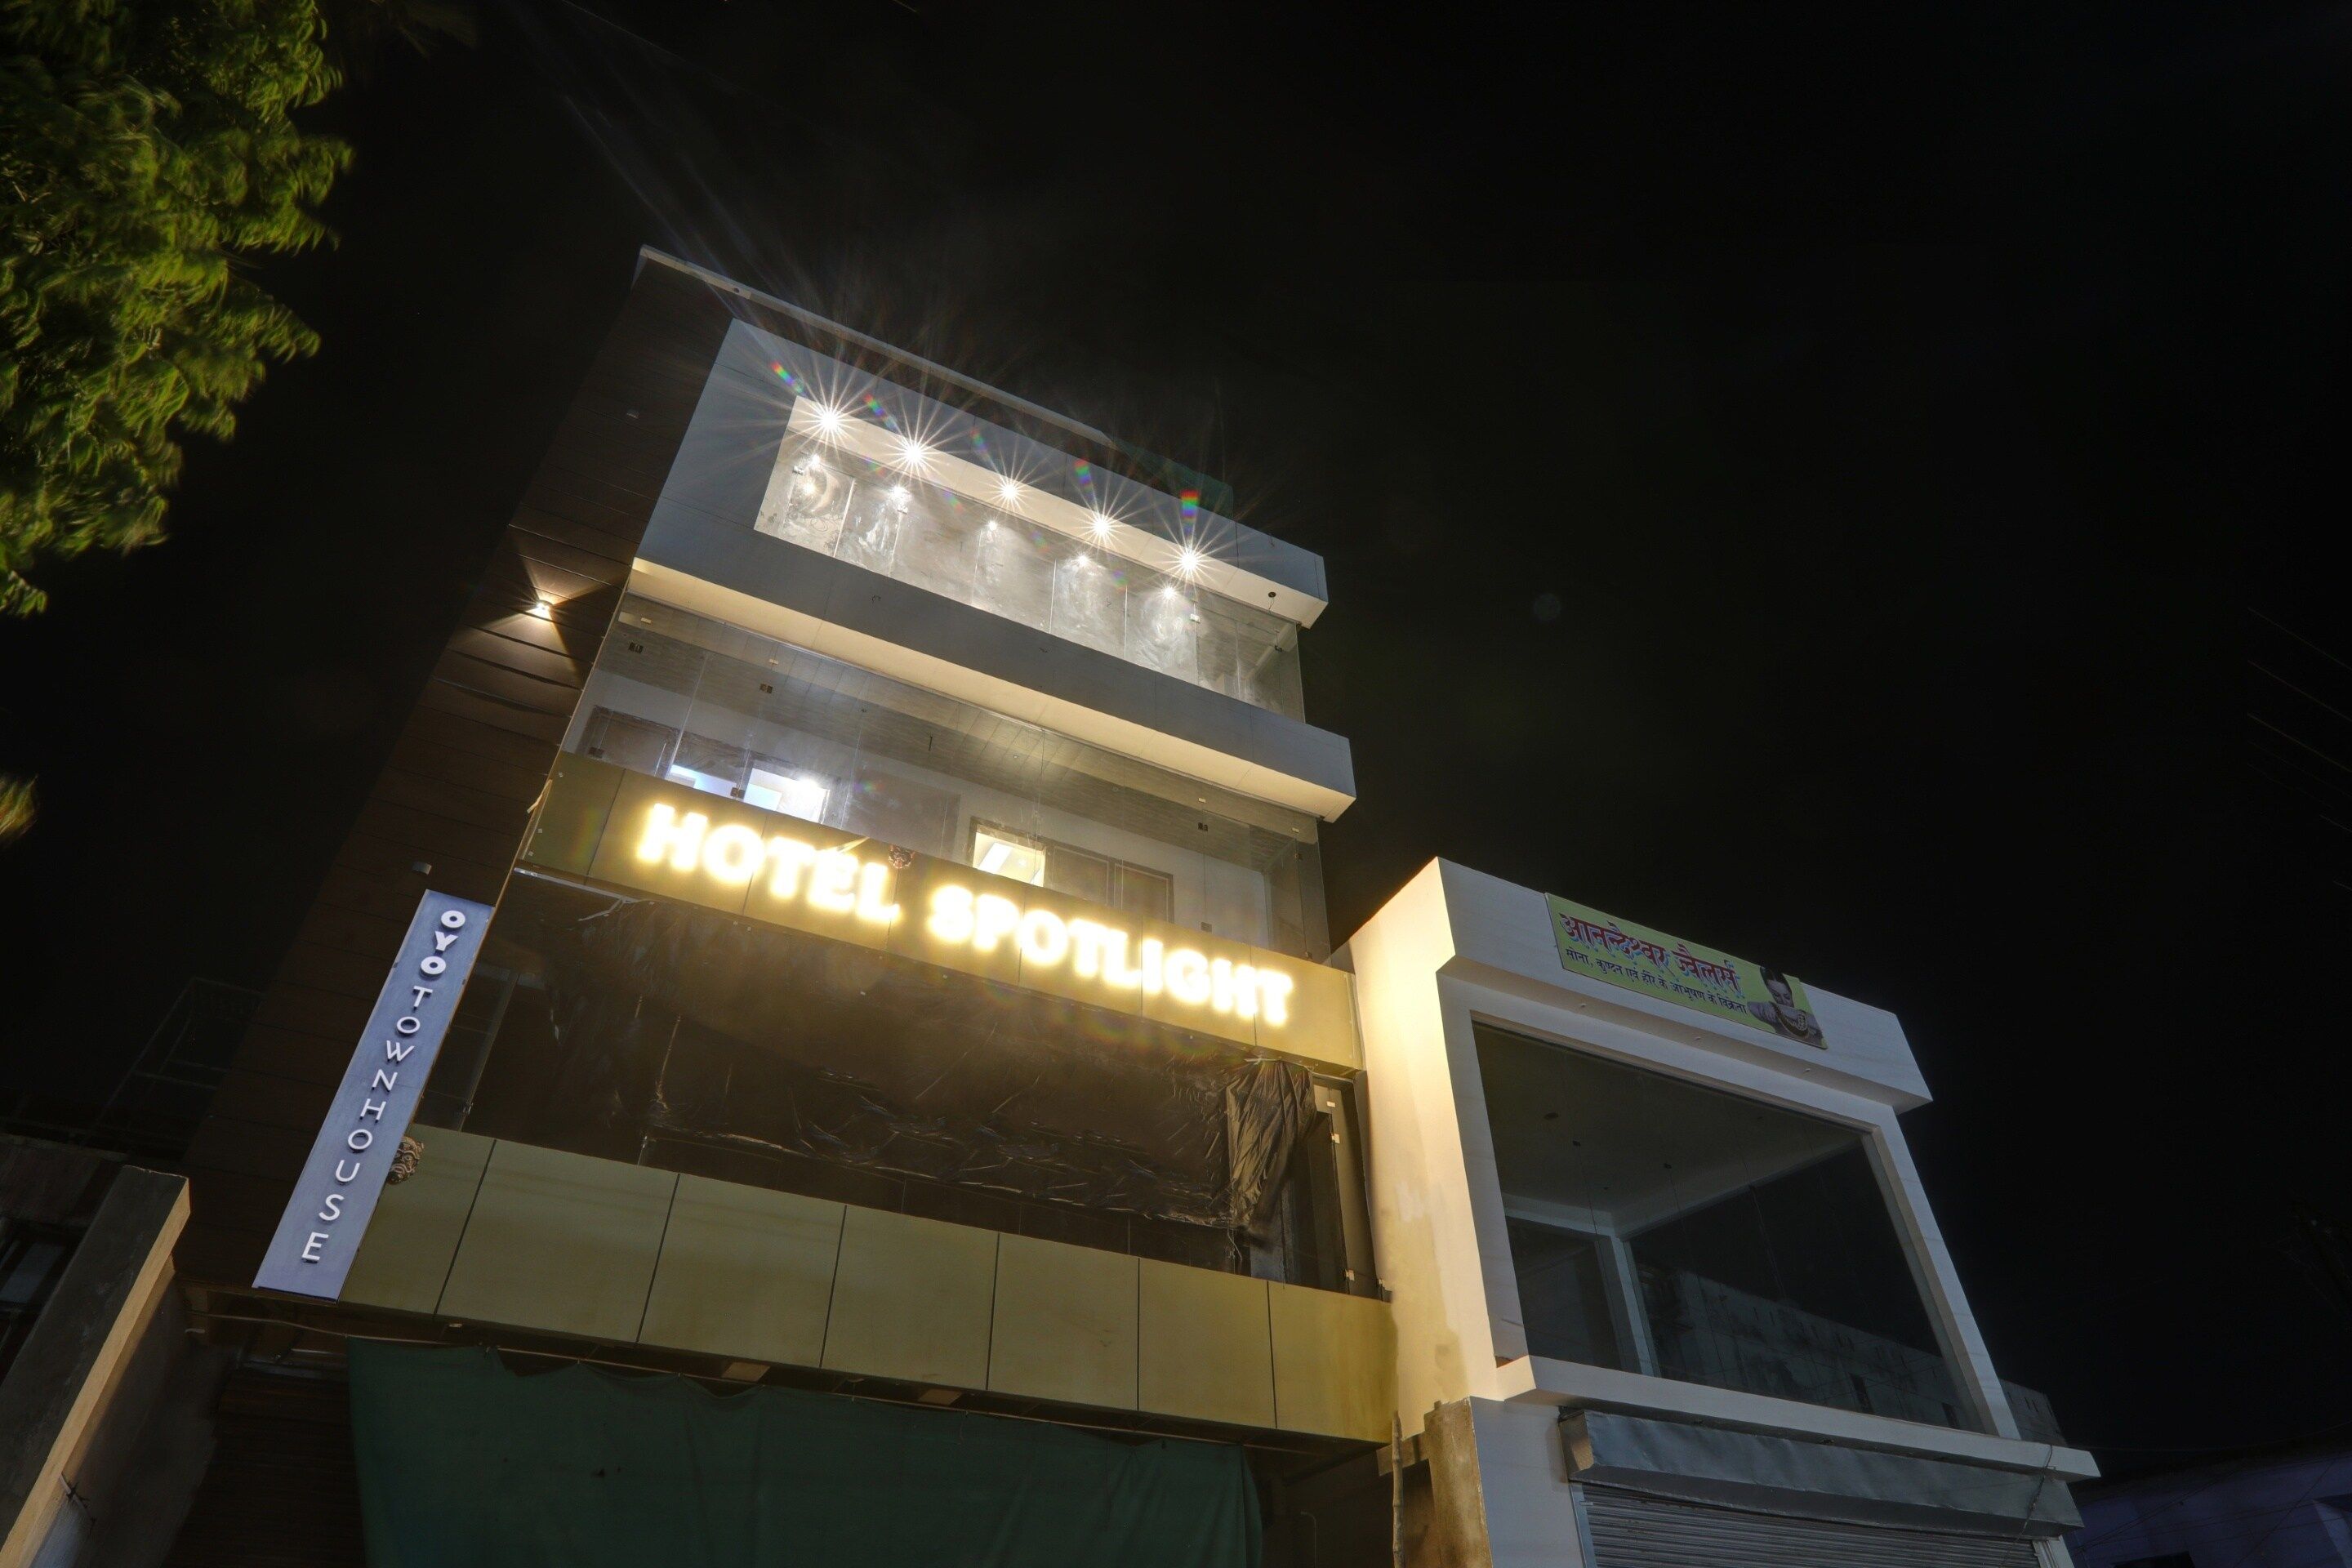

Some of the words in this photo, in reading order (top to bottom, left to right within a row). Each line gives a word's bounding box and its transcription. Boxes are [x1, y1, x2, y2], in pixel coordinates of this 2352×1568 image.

[420, 910, 466, 977] OYO
[638, 804, 902, 922] HOTEL
[928, 884, 1294, 1027] SPOTLIGHT
[1672, 942, 1744, 998] ज्वैलर्स
[301, 986, 433, 1263] TOWNHOUSE
